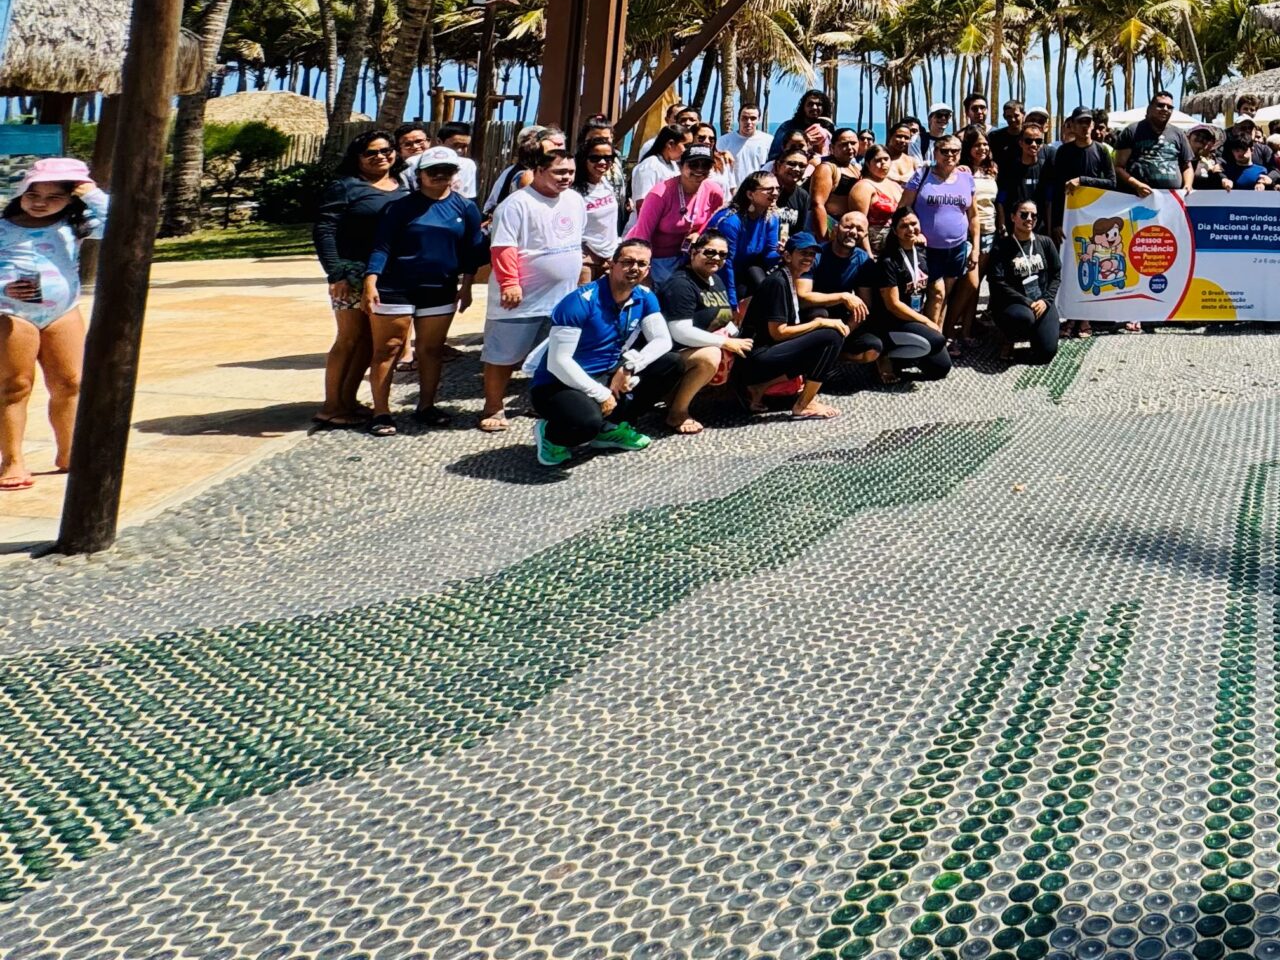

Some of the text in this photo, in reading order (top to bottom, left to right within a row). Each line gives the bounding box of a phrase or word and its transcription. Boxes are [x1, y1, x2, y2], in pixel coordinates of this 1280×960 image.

[1229, 213, 1277, 222] Bem-vindos
[1213, 223, 1249, 231] Nacional
[1209, 233, 1242, 242] Parques
[1131, 244, 1174, 252] deficiência
